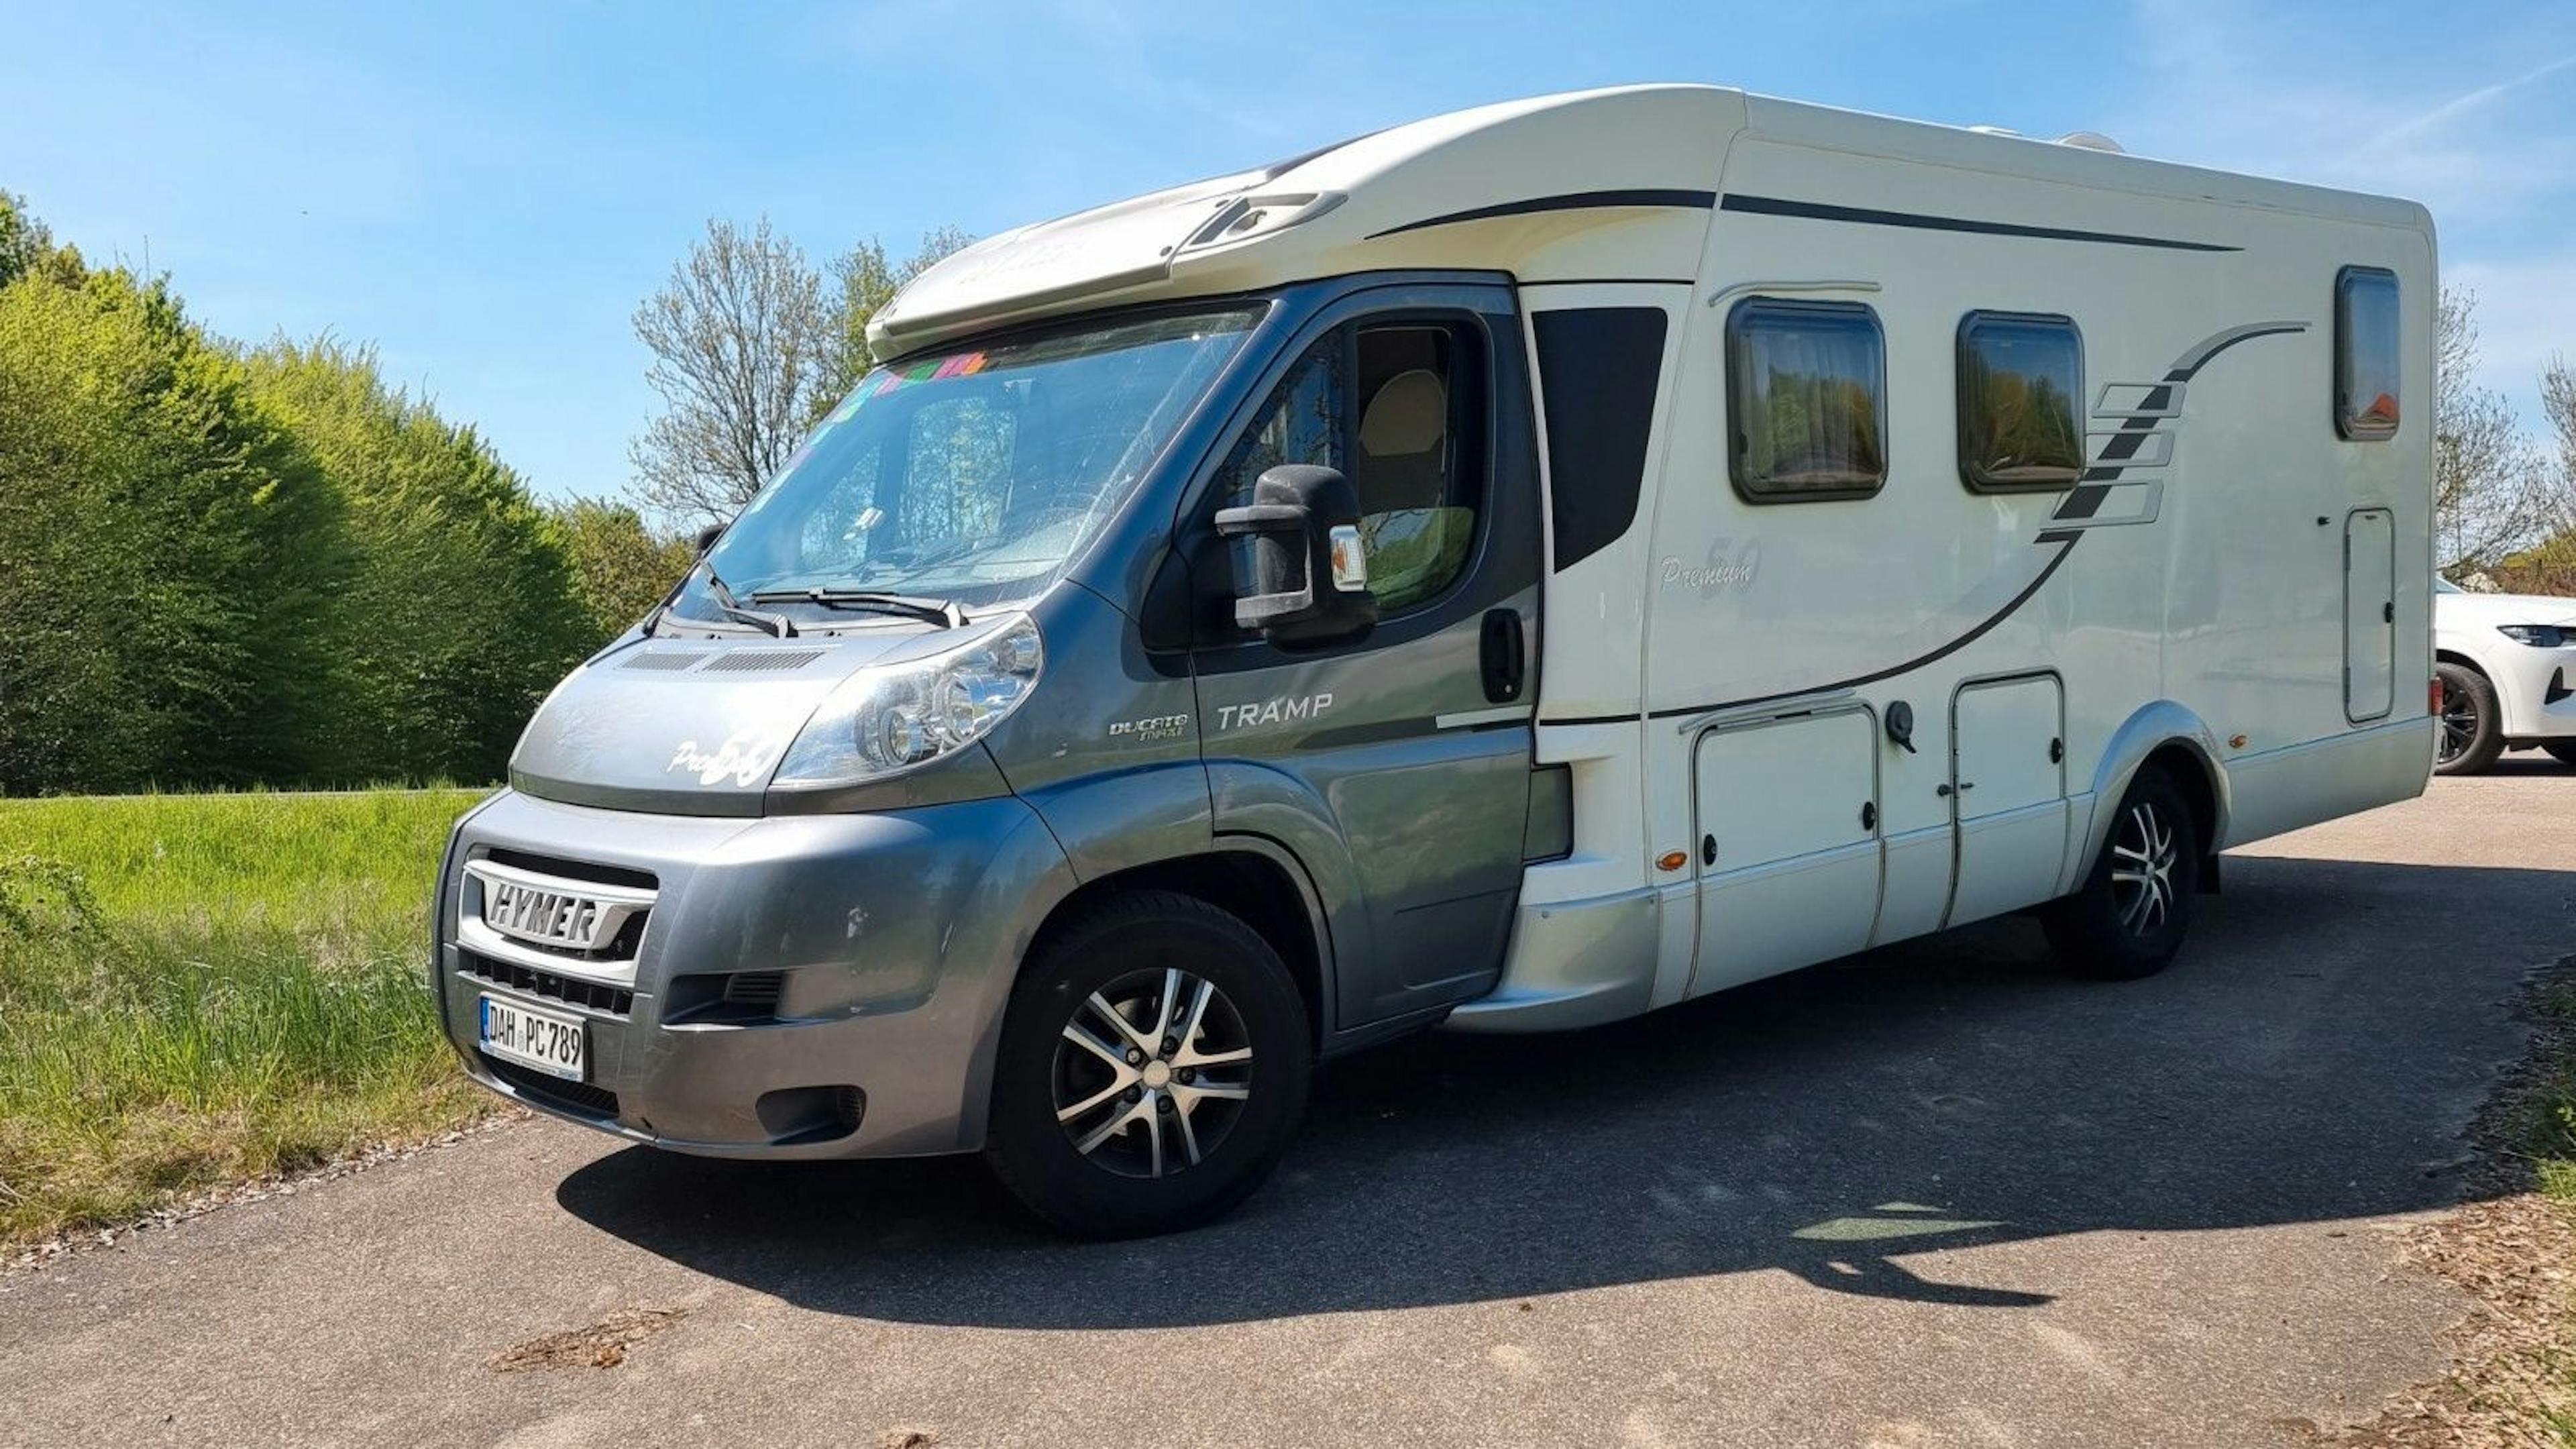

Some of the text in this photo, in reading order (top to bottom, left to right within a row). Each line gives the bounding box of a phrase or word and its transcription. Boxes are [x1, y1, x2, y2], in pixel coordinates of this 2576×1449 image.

[1660, 555, 1750, 592] Premium
[1109, 714, 1188, 735] DUCATO
[1218, 693, 1332, 730] TRAMP
[490, 883, 596, 942] HYMER
[490, 1006, 515, 1047] DAH
[526, 1016, 545, 1057] PC
[549, 1022, 581, 1067] 789
